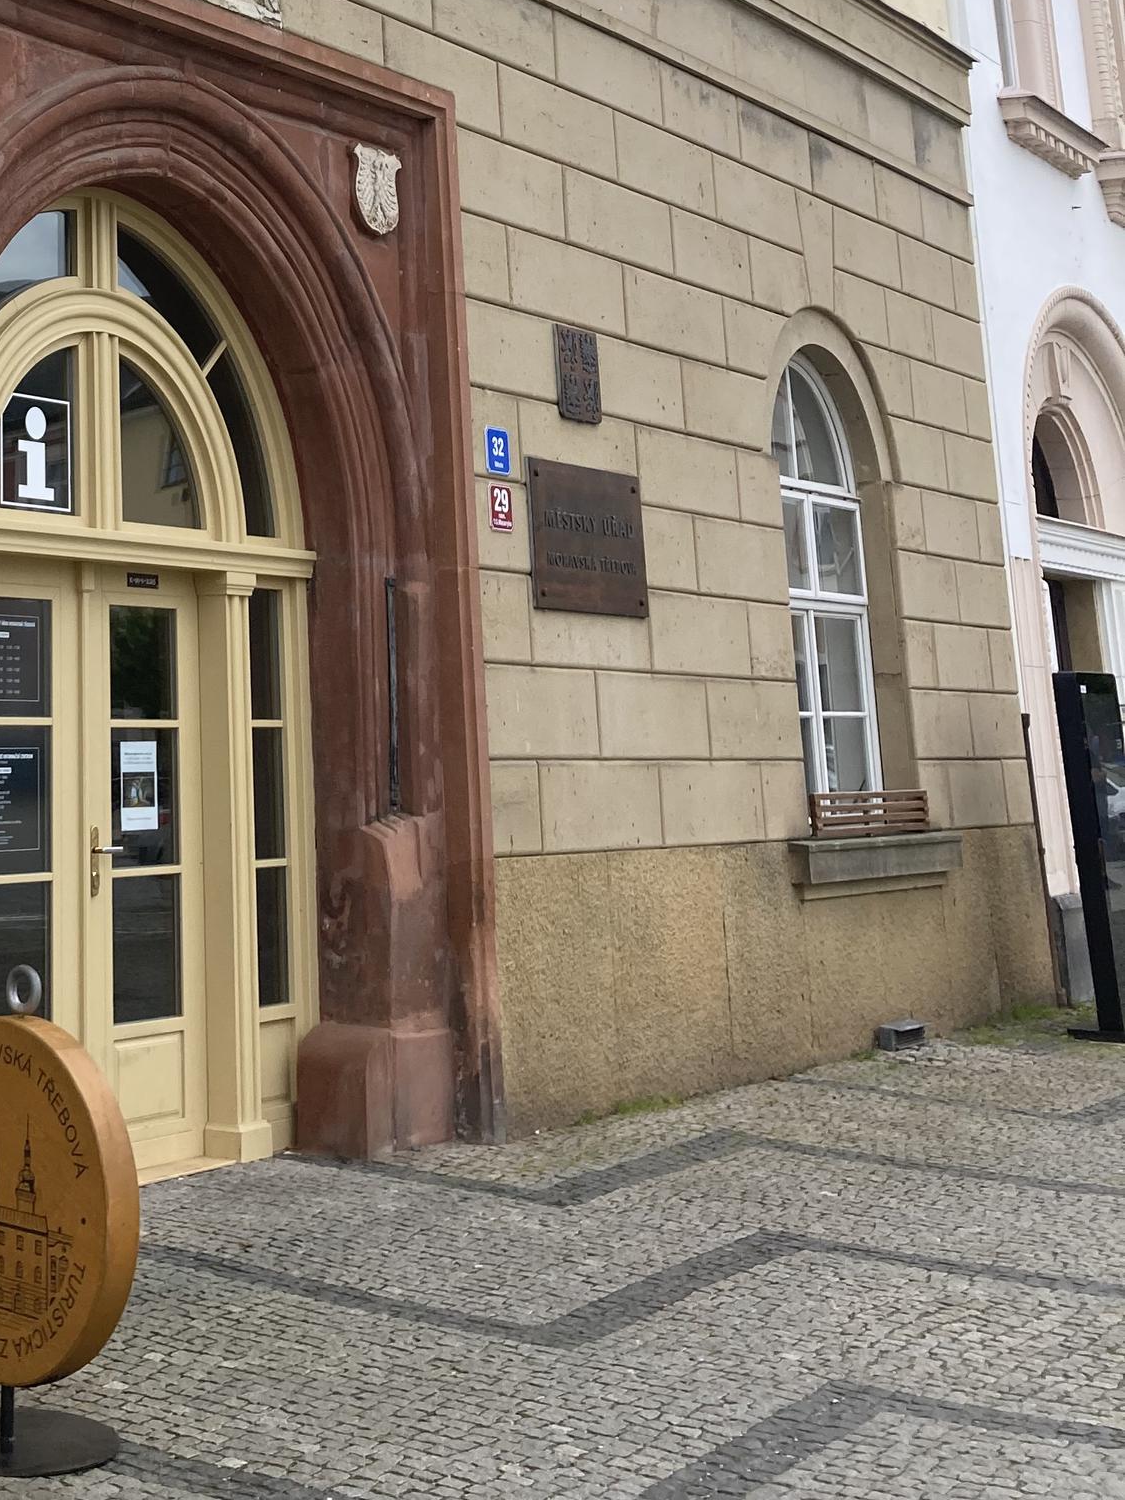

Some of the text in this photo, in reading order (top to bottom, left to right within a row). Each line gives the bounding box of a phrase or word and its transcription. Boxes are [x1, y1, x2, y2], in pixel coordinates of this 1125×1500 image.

[491, 436, 505, 457] 32
[494, 487, 509, 513] 29
[11, 1262, 87, 1362] TURISTICKÁ
